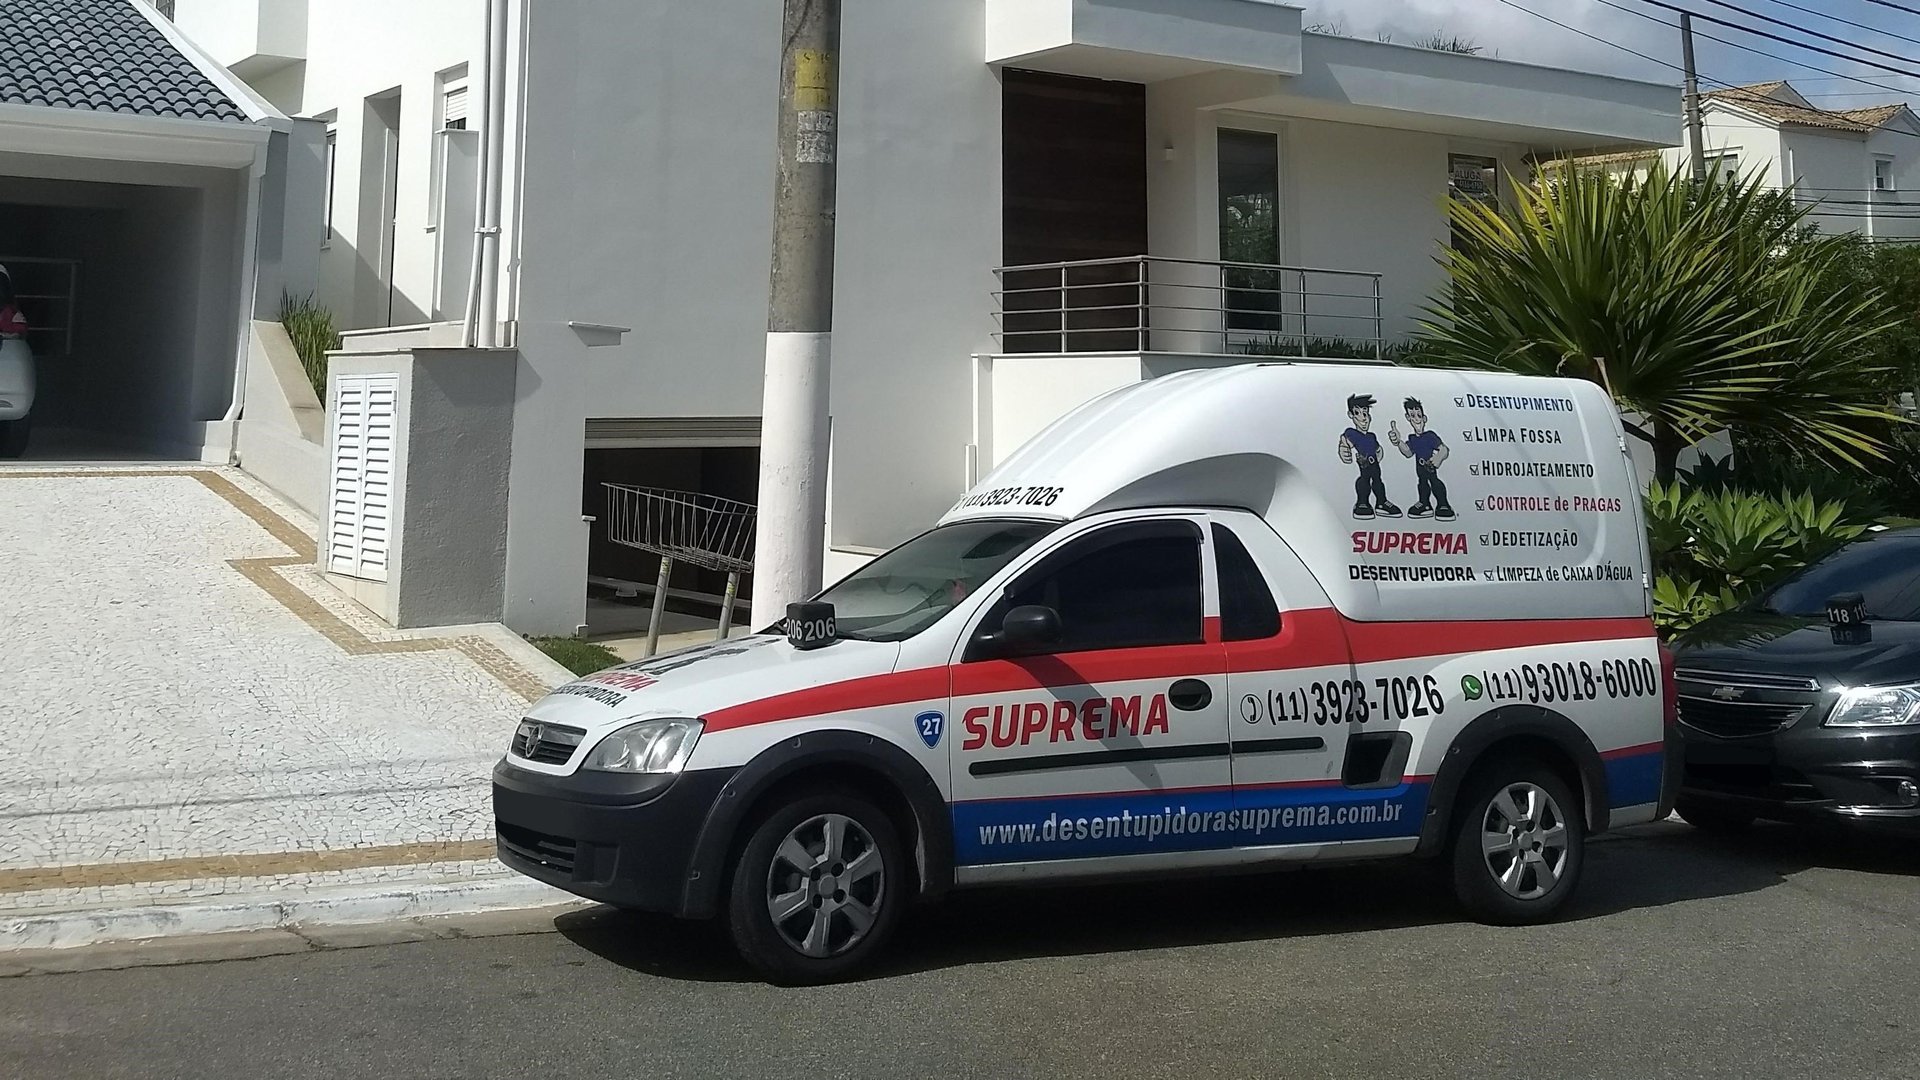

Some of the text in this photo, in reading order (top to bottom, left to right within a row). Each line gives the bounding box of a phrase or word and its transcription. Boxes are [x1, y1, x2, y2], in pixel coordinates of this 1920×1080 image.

[1466, 394, 1574, 412] DESENTUPIMENTO
[1475, 426, 1562, 444] LIMPA FOSSA
[1482, 460, 1594, 478] HIDROJATEAMENTO
[1487, 495, 1621, 512] CONTROLE de PRAGAS
[1351, 531, 1468, 555] SUPREMA
[1492, 529, 1578, 550] DEDETIZAÇÃO
[1348, 565, 1476, 581] DESENTUPIDORA
[1496, 561, 1633, 581] LIMPEZA de CAIXA D'ÁGUA
[1827, 607, 1850, 623] 118
[787, 617, 803, 640] 206
[804, 616, 836, 642] 206
[922, 717, 942, 736] 27
[961, 693, 1169, 751] SUPREMA
[979, 800, 1403, 845] www.desentupidorasuprema.com.br
